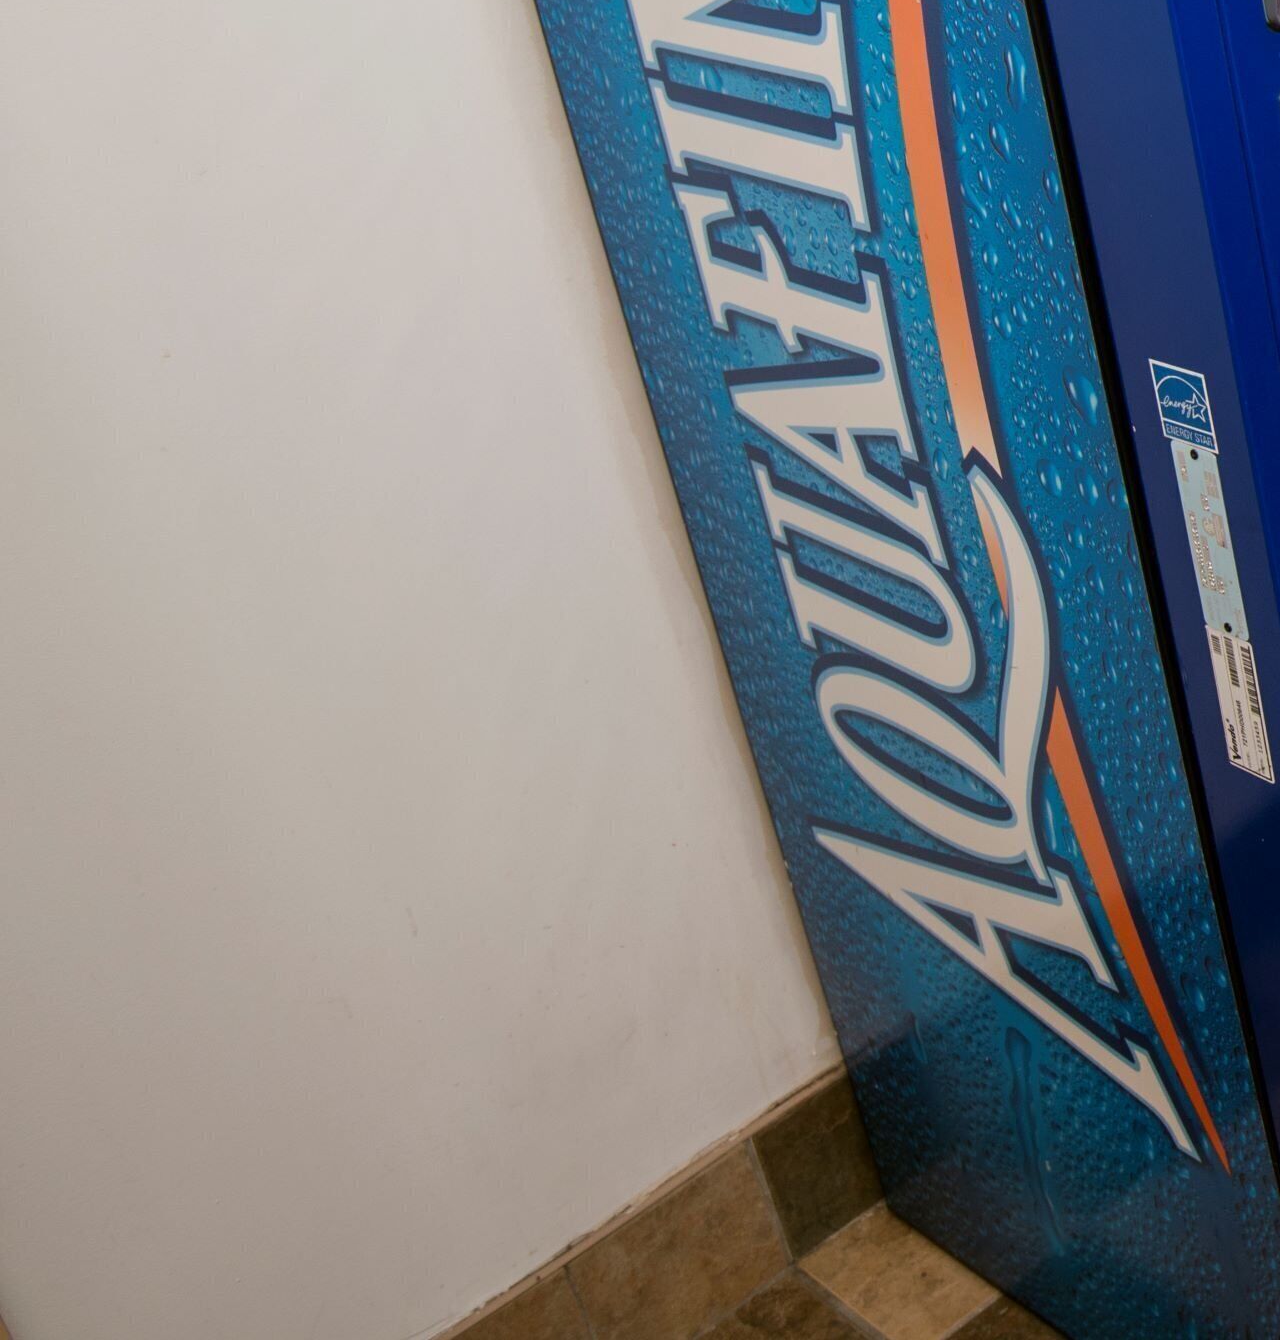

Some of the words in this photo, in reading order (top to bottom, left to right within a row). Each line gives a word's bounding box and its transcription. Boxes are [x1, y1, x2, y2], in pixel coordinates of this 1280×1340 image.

[1160, 395, 1195, 419] energy
[1166, 423, 1193, 441] ENERGY
[1194, 432, 1214, 447] STAR
[1227, 723, 1243, 761] Vendo
